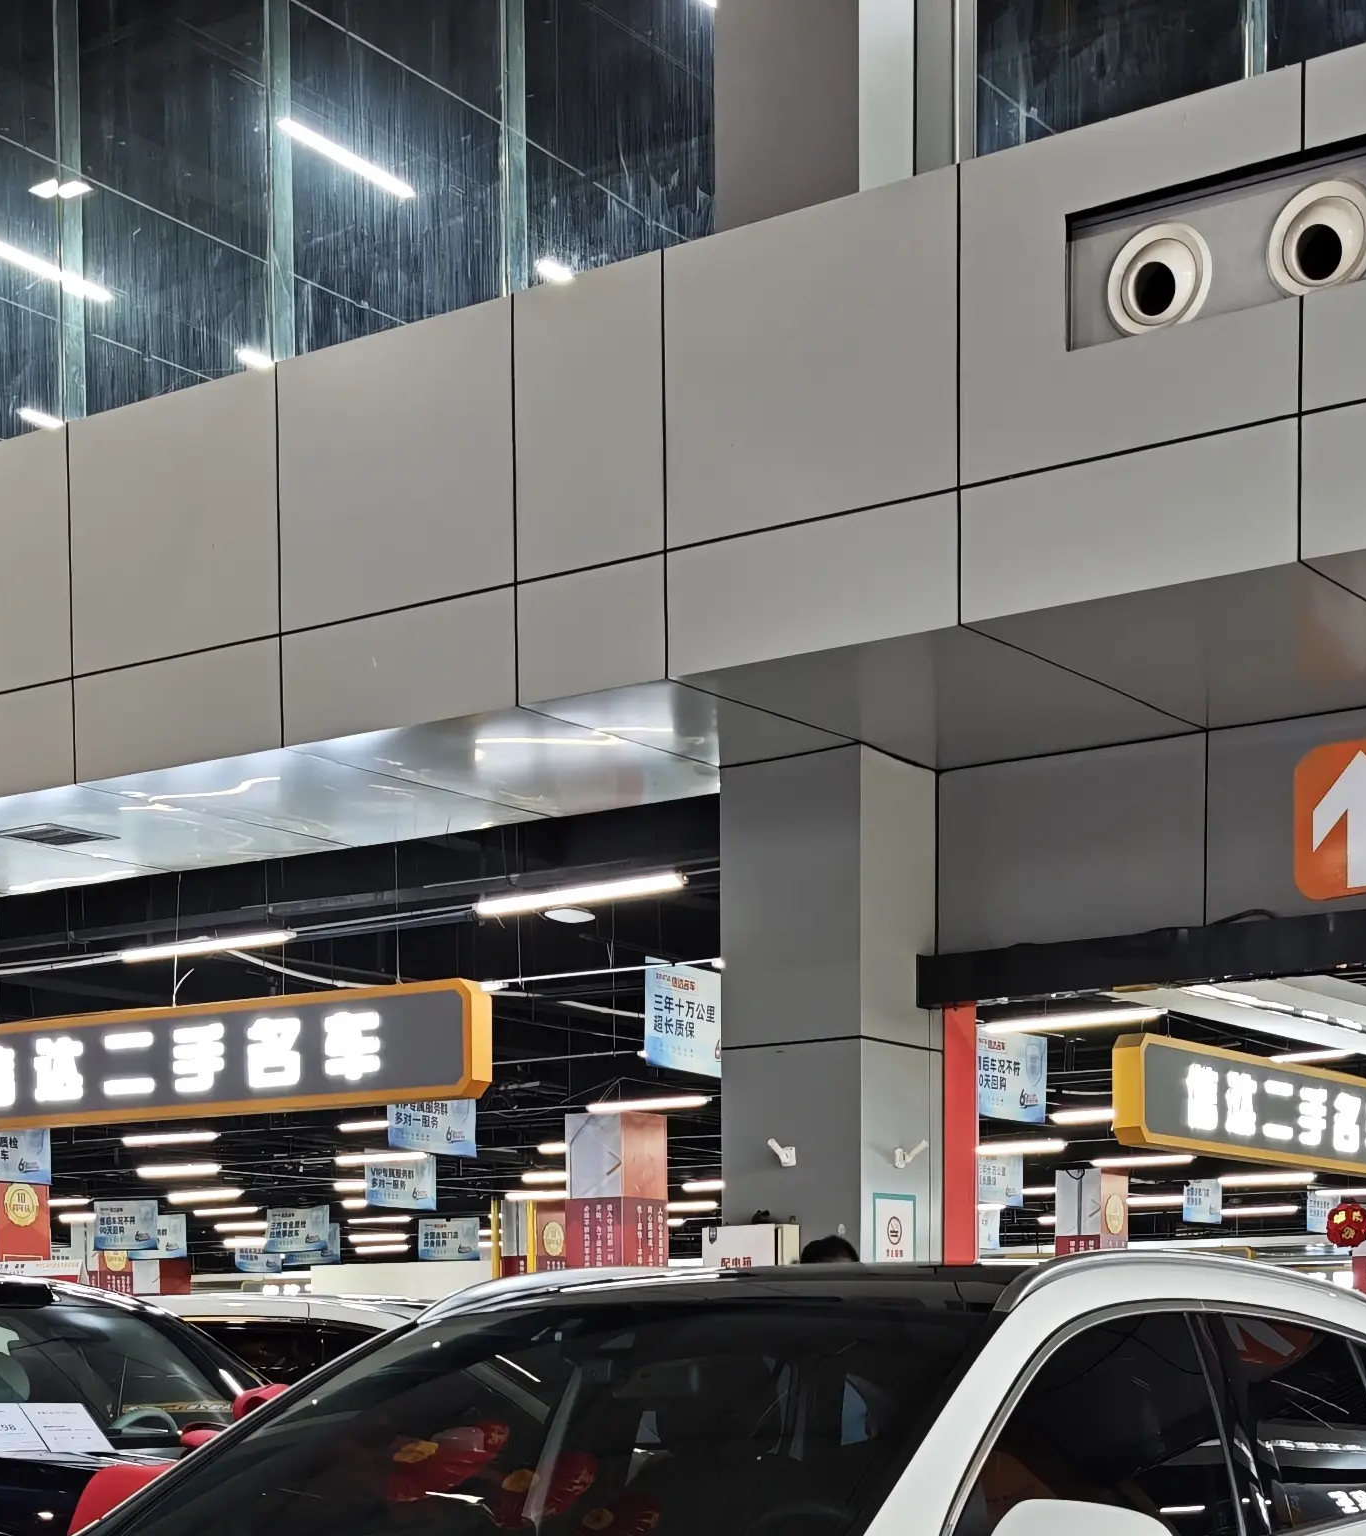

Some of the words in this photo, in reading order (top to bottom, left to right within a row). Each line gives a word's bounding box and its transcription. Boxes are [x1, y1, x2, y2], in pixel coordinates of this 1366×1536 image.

[653, 993, 716, 1024] 三年十万公里
[653, 1015, 695, 1039] 超长质保
[978, 1074, 1007, 1092] 0天回购
[394, 1112, 439, 1129] 多对一服务
[370, 1178, 407, 1191] 多对一服务
[720, 1256, 752, 1268] 配电箱
